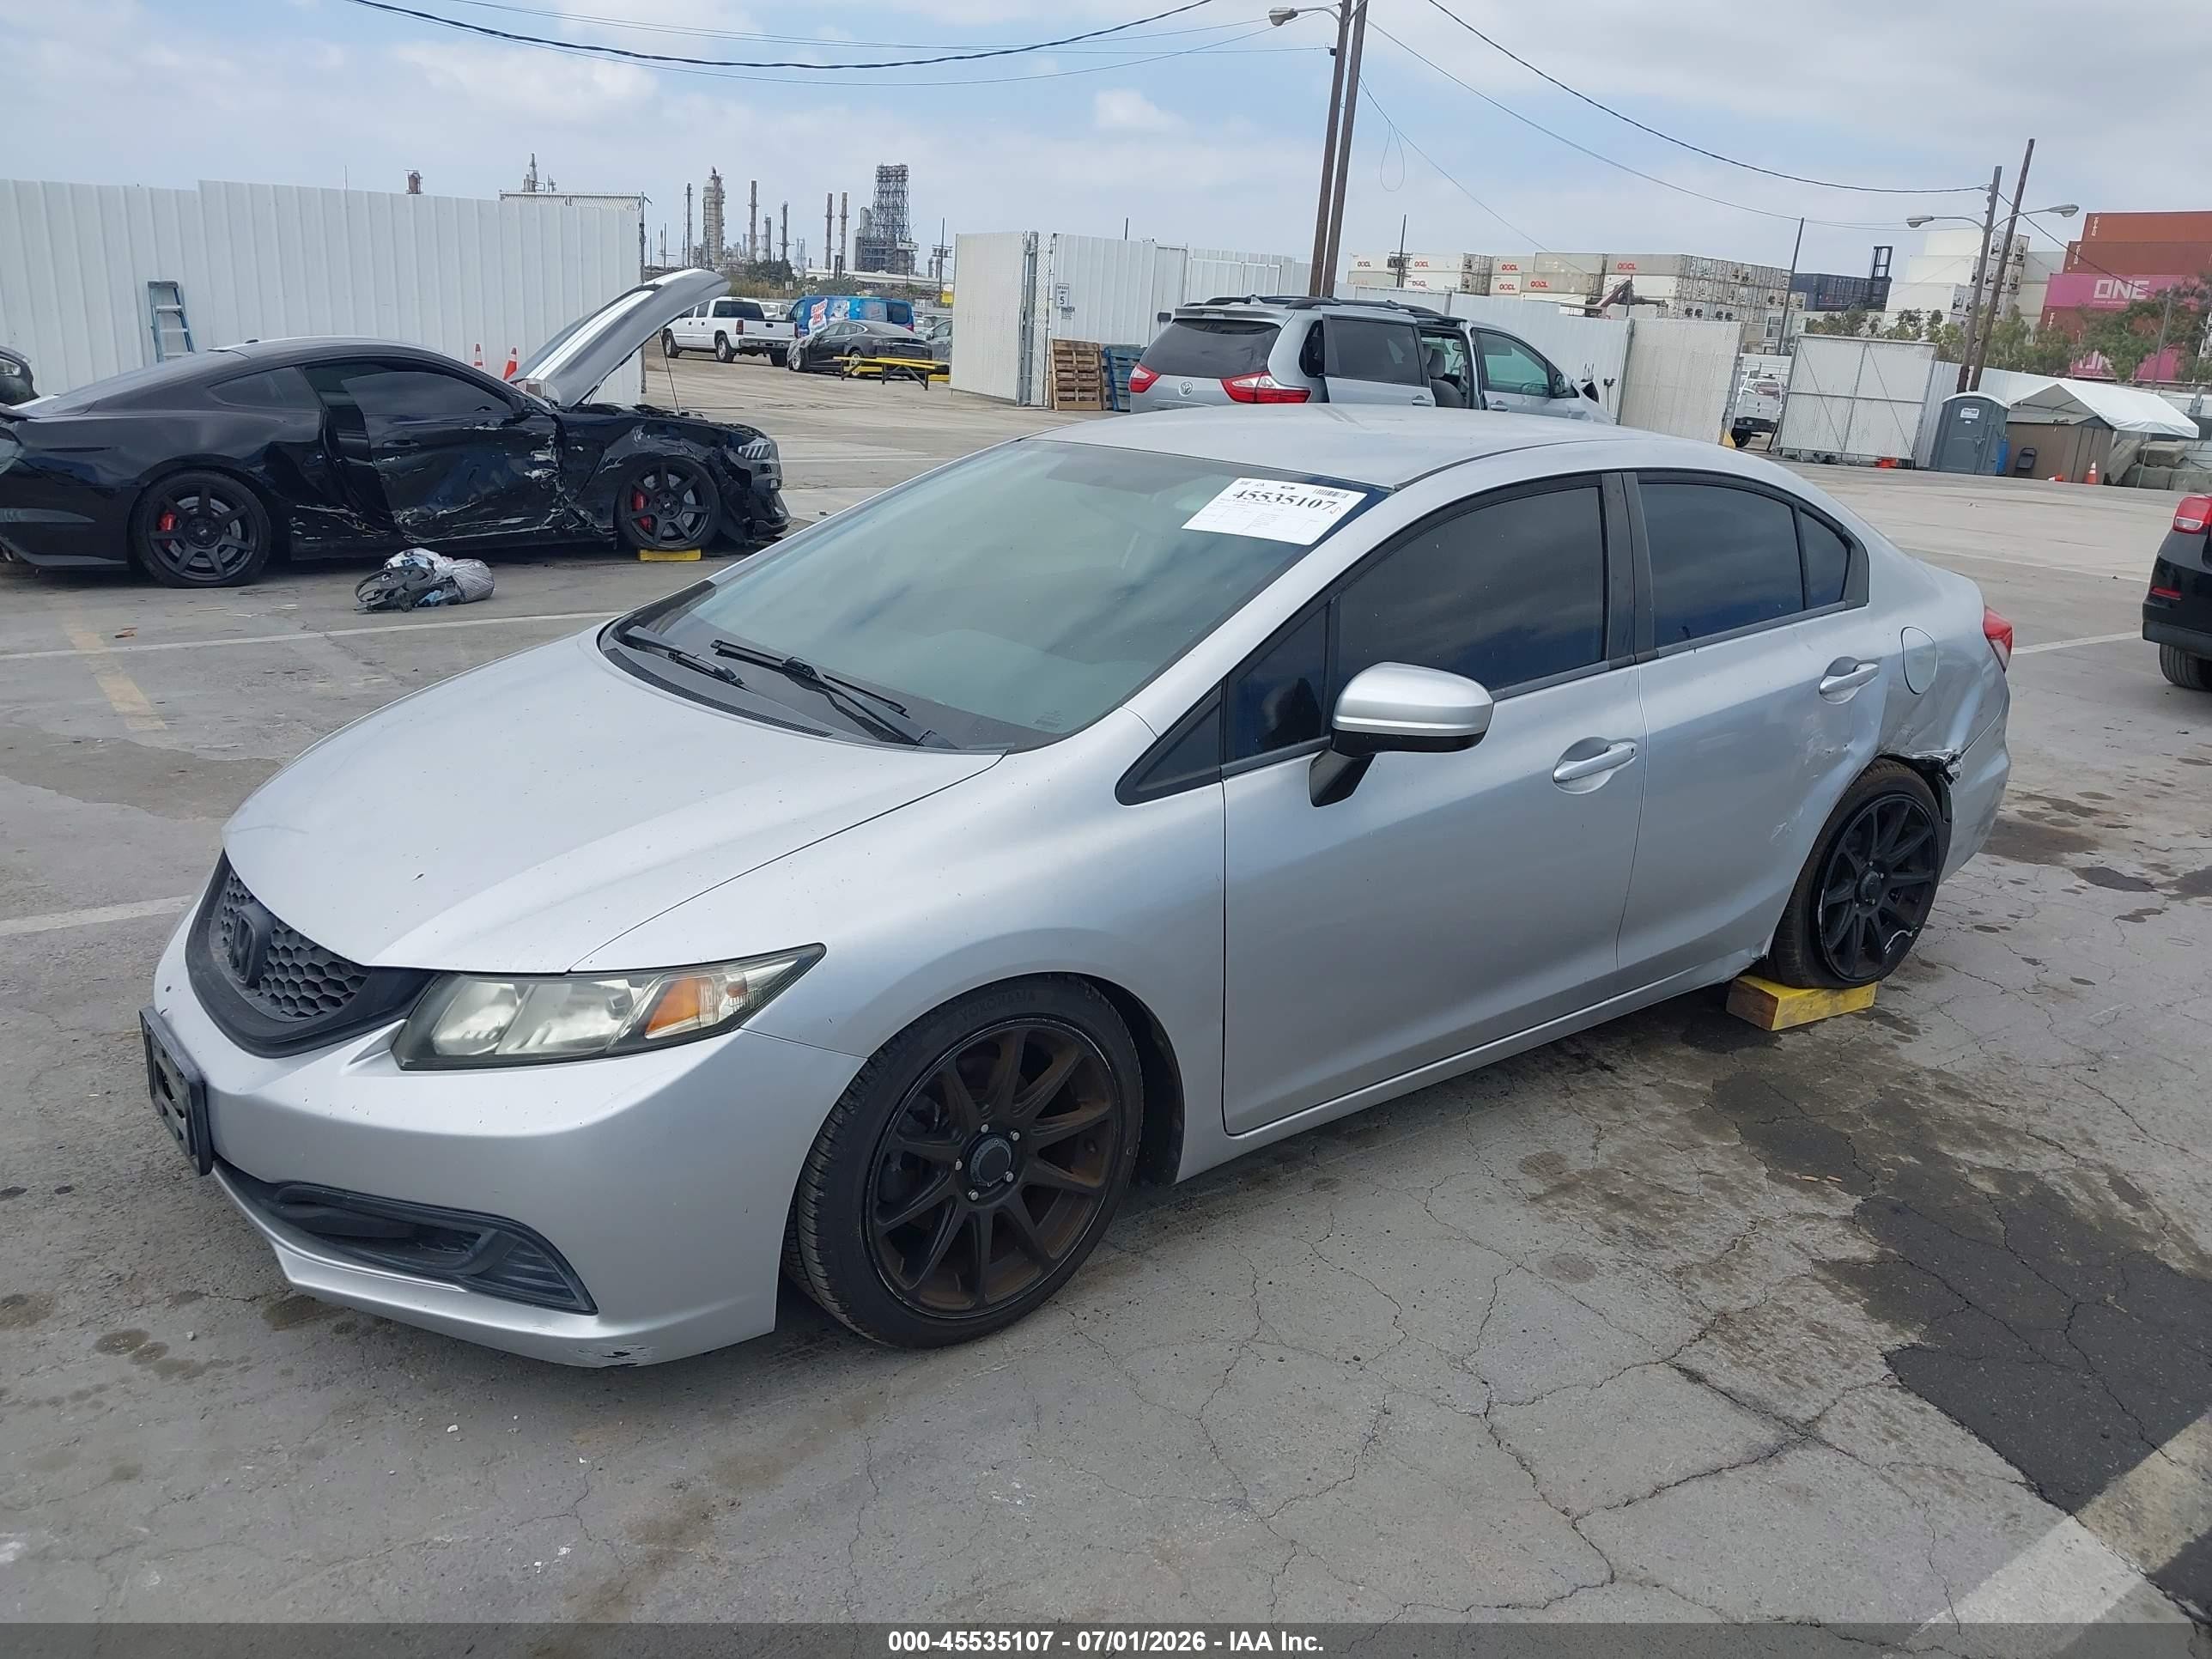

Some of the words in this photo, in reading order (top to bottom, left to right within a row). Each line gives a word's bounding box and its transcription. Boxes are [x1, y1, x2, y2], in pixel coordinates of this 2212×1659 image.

[2094, 279, 2149, 300] ONE
[1060, 296, 1065, 305] 5
[1233, 490, 1337, 510] 45535107
[959, 989, 1036, 1022] YOKOHAMA
